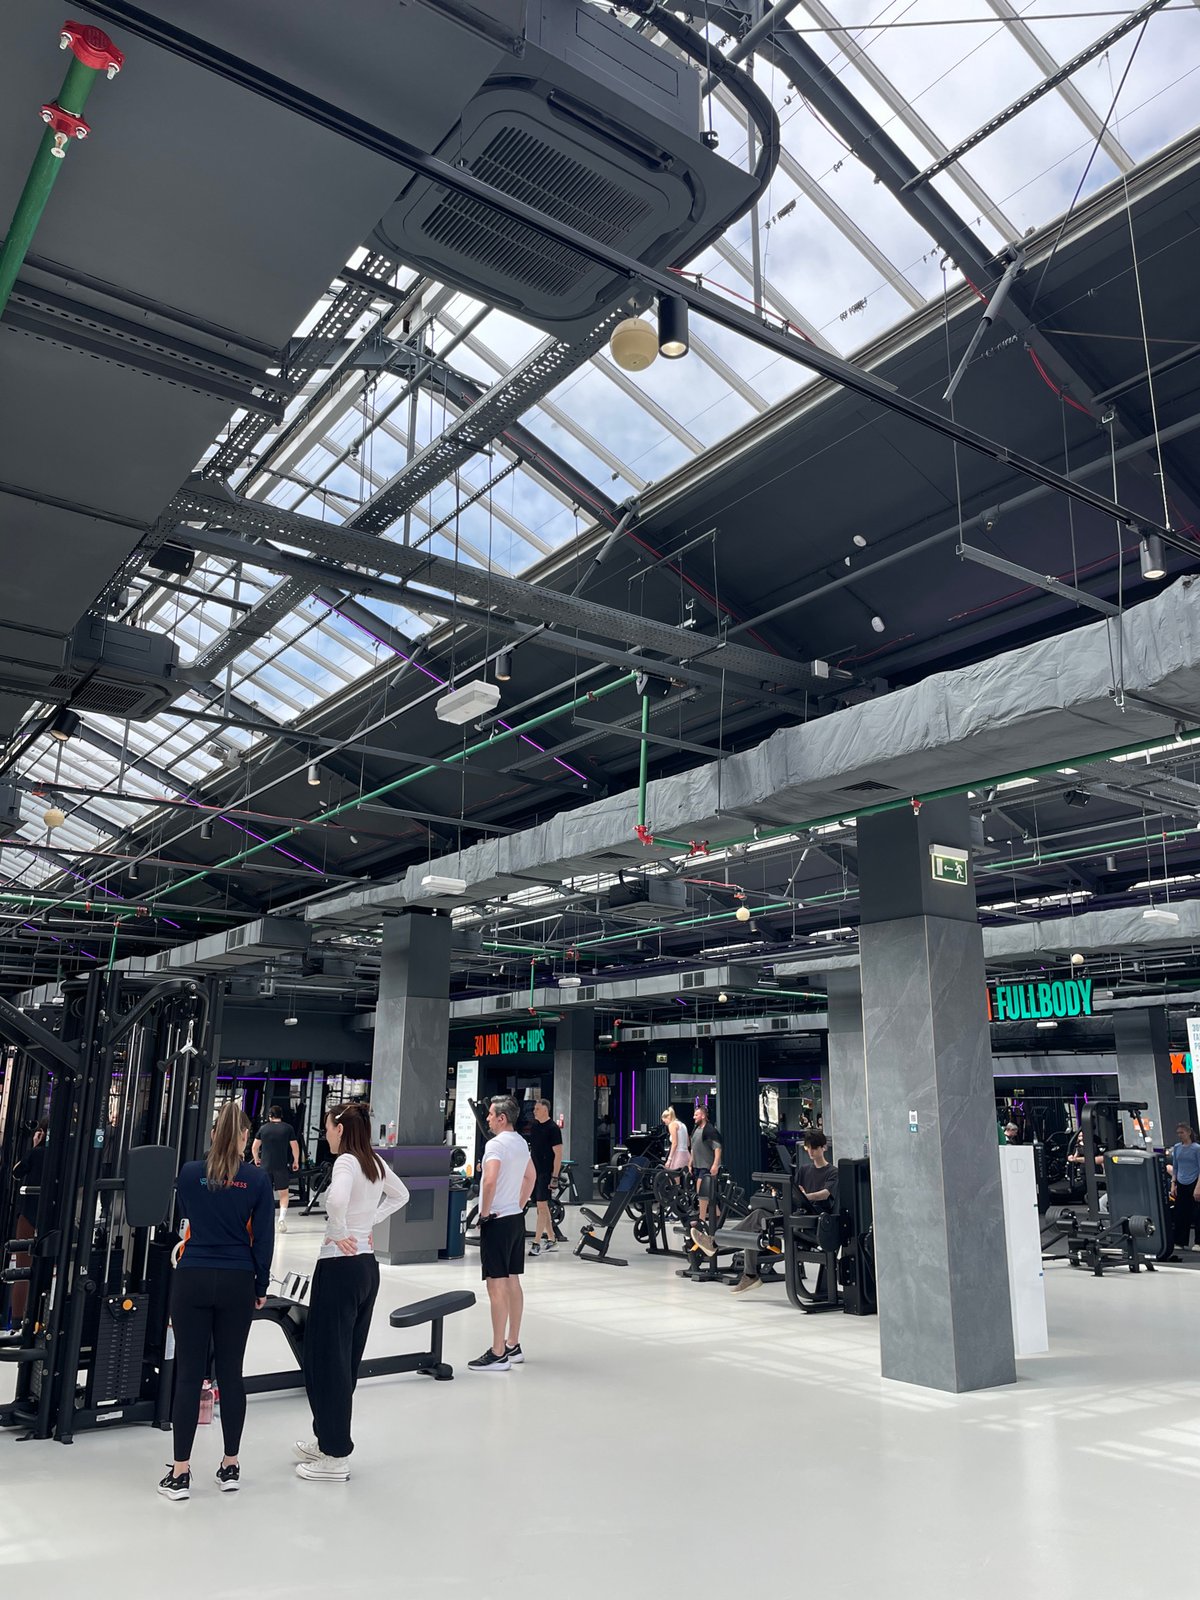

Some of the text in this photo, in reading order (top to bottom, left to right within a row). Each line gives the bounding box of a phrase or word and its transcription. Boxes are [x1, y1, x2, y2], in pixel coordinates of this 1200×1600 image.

[996, 979, 1092, 1020] FULLBODY
[474, 1029, 545, 1057] 30 MIN LEGS + HIPS
